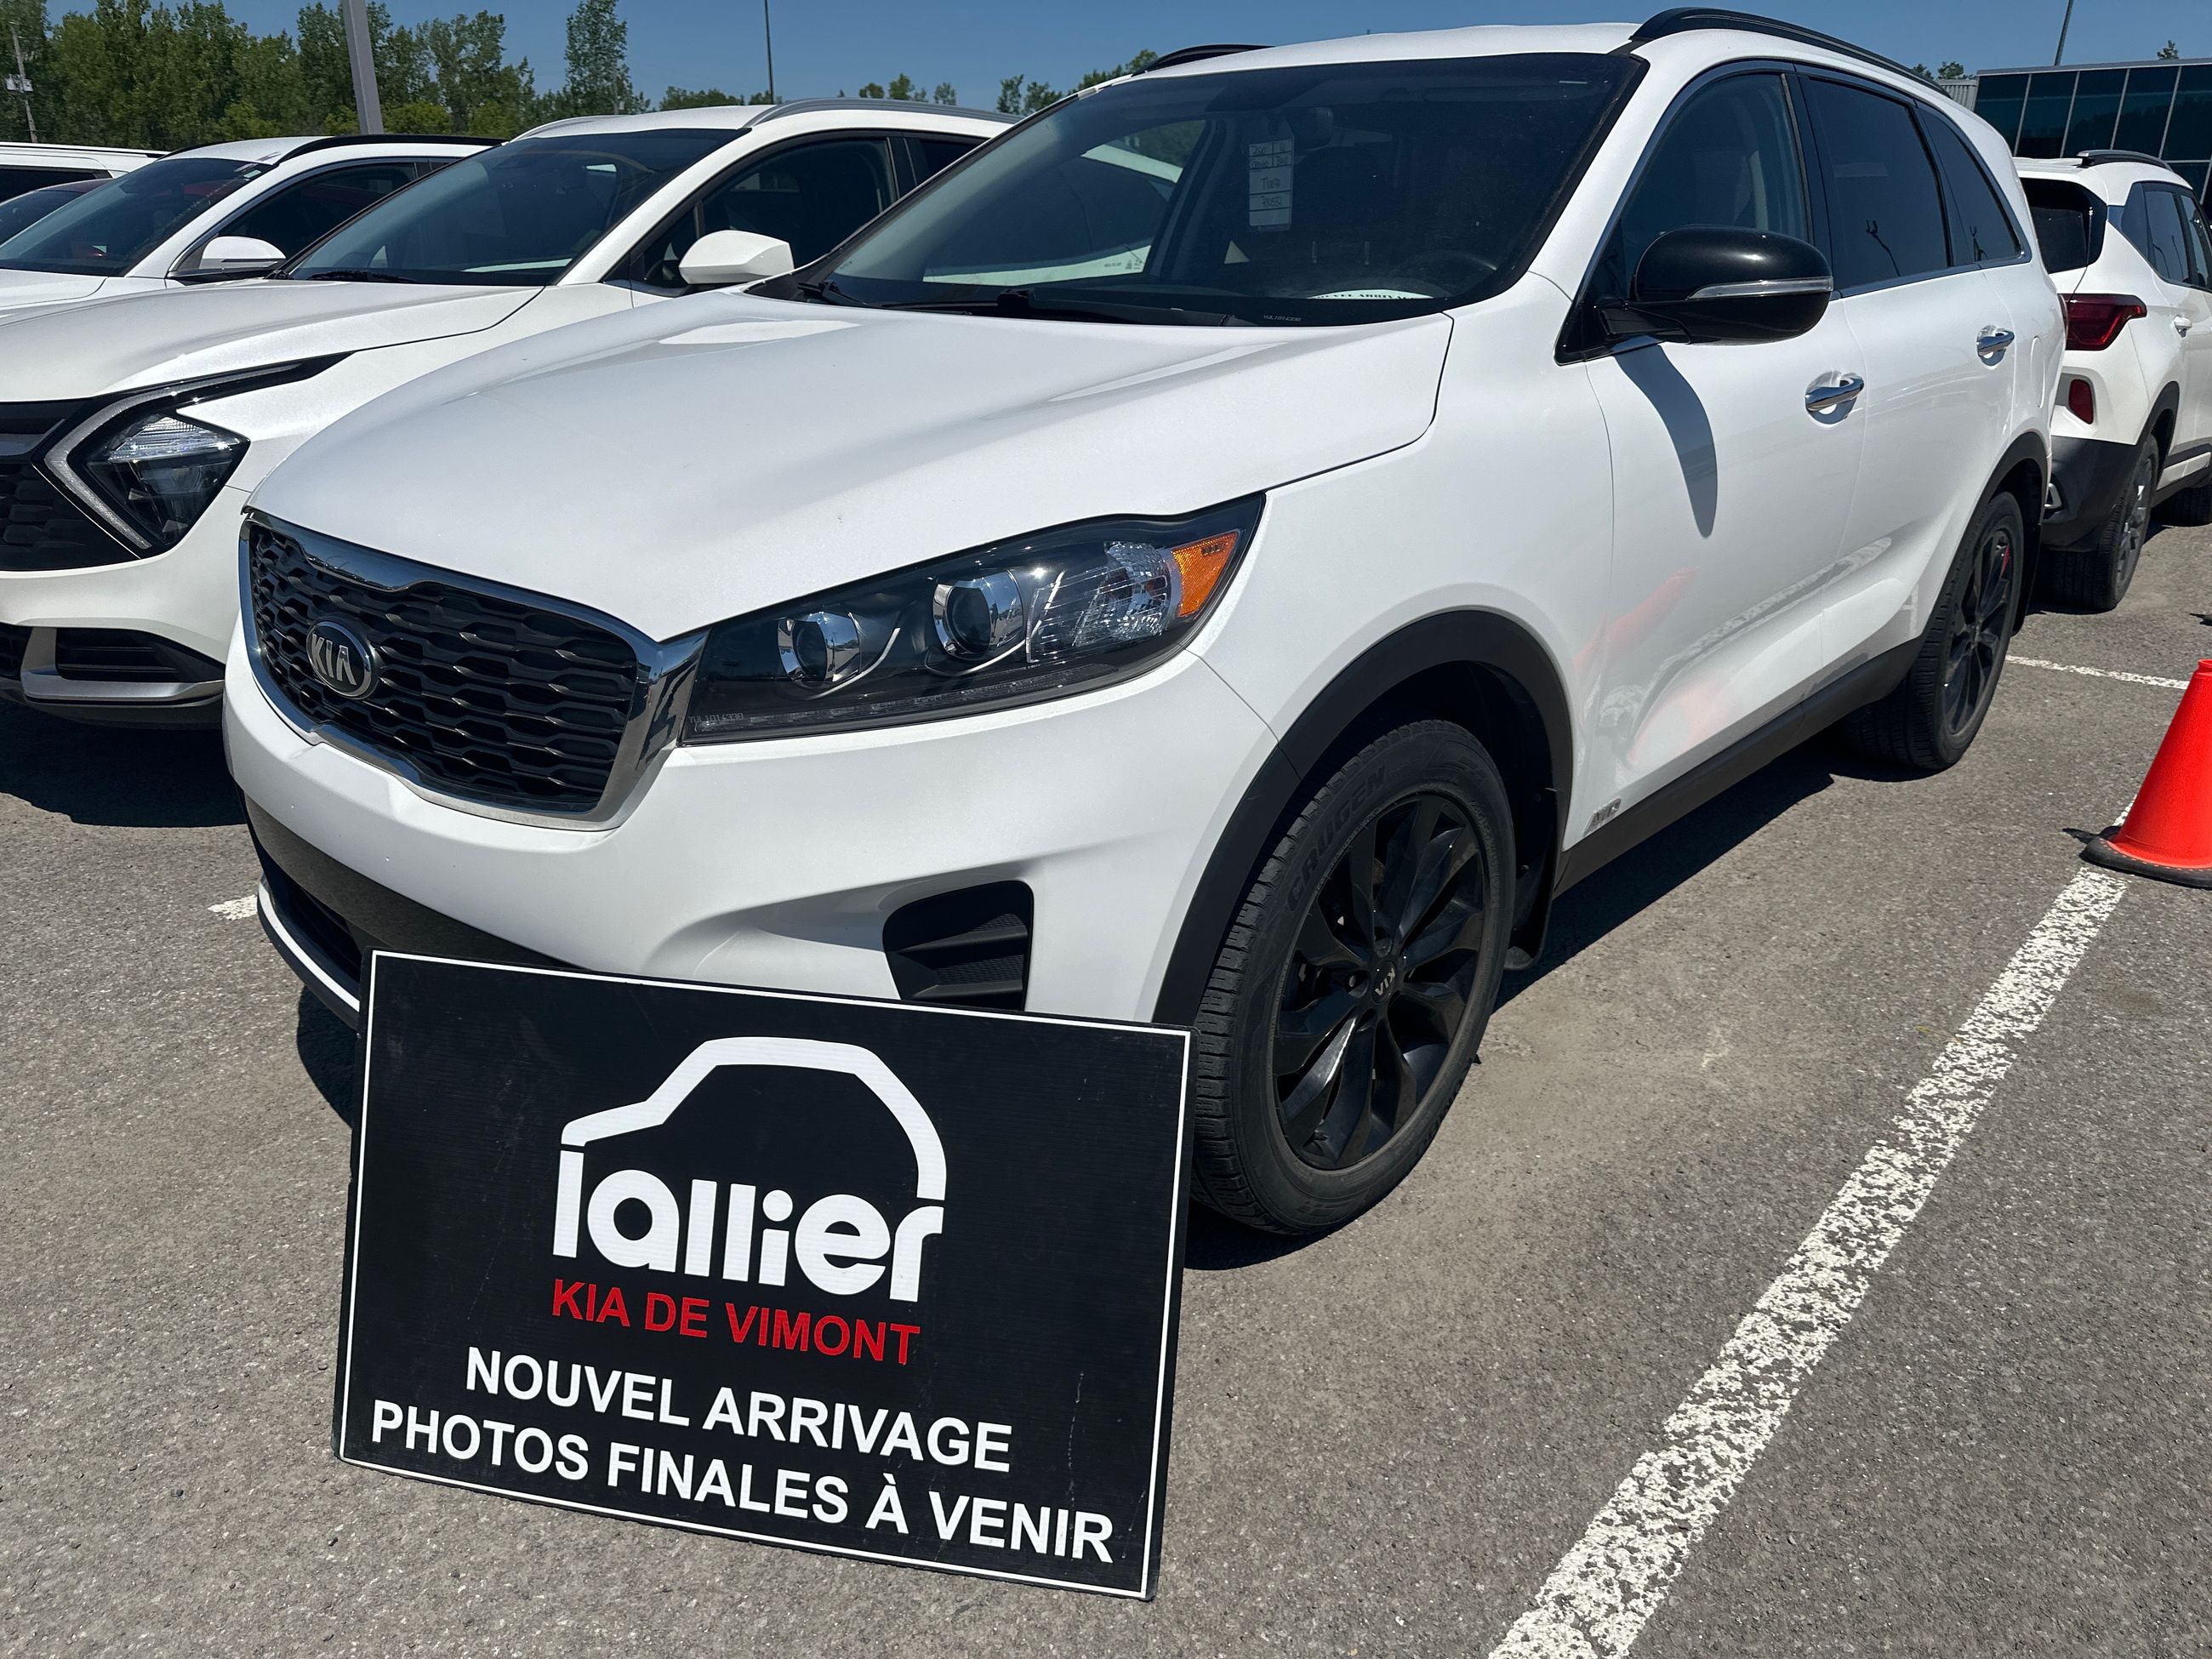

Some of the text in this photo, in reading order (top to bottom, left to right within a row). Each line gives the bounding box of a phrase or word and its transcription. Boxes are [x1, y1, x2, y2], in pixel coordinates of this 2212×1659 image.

[311, 633, 357, 686] KIA
[1375, 967, 1396, 996] KIA
[552, 1279, 921, 1365] KIA DE VIMONT
[466, 1346, 1012, 1473] NOUVEL ARRIVAGE
[372, 1399, 1115, 1564] PHOTOS FINALES À VENIR
